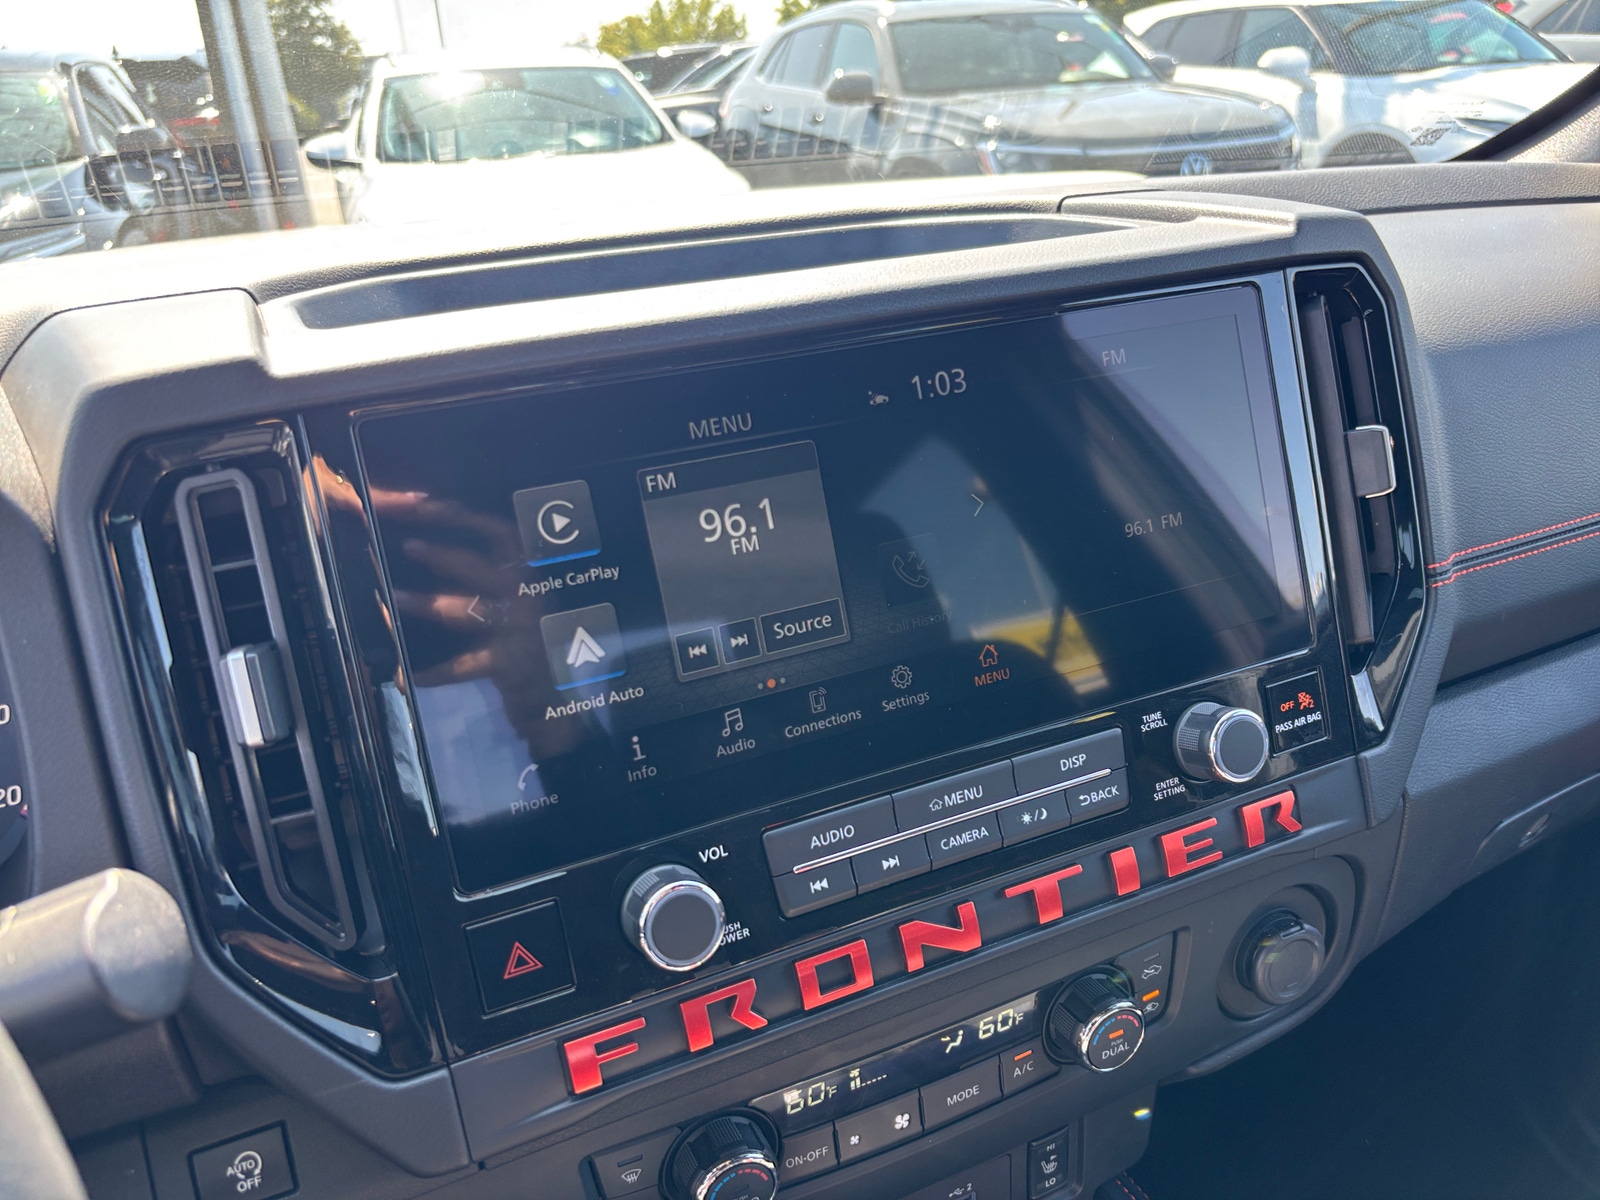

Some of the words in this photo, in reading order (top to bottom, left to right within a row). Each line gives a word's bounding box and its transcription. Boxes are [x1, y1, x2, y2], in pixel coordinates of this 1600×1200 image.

[1102, 349, 1127, 367] FM
[911, 368, 967, 400] 1:03
[689, 413, 752, 439] MENU
[646, 472, 677, 493] FM
[699, 497, 776, 543] 96.1
[1124, 518, 1154, 538] 96.1
[1161, 512, 1183, 530] FM
[729, 535, 761, 555] FM
[518, 575, 563, 597] Apple
[566, 565, 620, 588] CarPlay
[773, 613, 833, 639] Source
[974, 668, 1010, 687] MENU
[545, 694, 606, 720] Android
[609, 685, 644, 704] Auto
[882, 690, 930, 712] Settings
[1280, 700, 1295, 712] OFF
[785, 708, 862, 738] Connections
[1140, 718, 1168, 733] SCROLL
[1142, 711, 1162, 724] TUNE
[1275, 720, 1293, 734] PASS
[1294, 716, 1307, 728] AIR
[1307, 711, 1322, 725] BAG
[716, 737, 756, 758] Audio
[1060, 753, 1087, 772] DISP
[627, 764, 657, 783] Info
[1153, 784, 1186, 801] SETTING
[1155, 777, 1180, 791] ENTER
[510, 791, 559, 815] Phone
[944, 785, 983, 808] MENU
[1090, 785, 1120, 803] BACK
[810, 824, 855, 850] AUDIO
[940, 826, 989, 851] CAMERA
[698, 845, 729, 863] VOL
[720, 927, 751, 946] OWER
[723, 921, 741, 934] USH
[563, 790, 1303, 1095] FRONTIER
[1102, 1041, 1130, 1060] DUAL
[1111, 1038, 1123, 1047] PUSH
[1013, 1060, 1034, 1078] A/C
[947, 1084, 980, 1106] MODE
[1046, 1143, 1056, 1151] HI
[226, 1159, 255, 1177] AUTO
[237, 1175, 262, 1193] OFF
[966, 1182, 973, 1191] 2
[1045, 1177, 1056, 1188] LO
